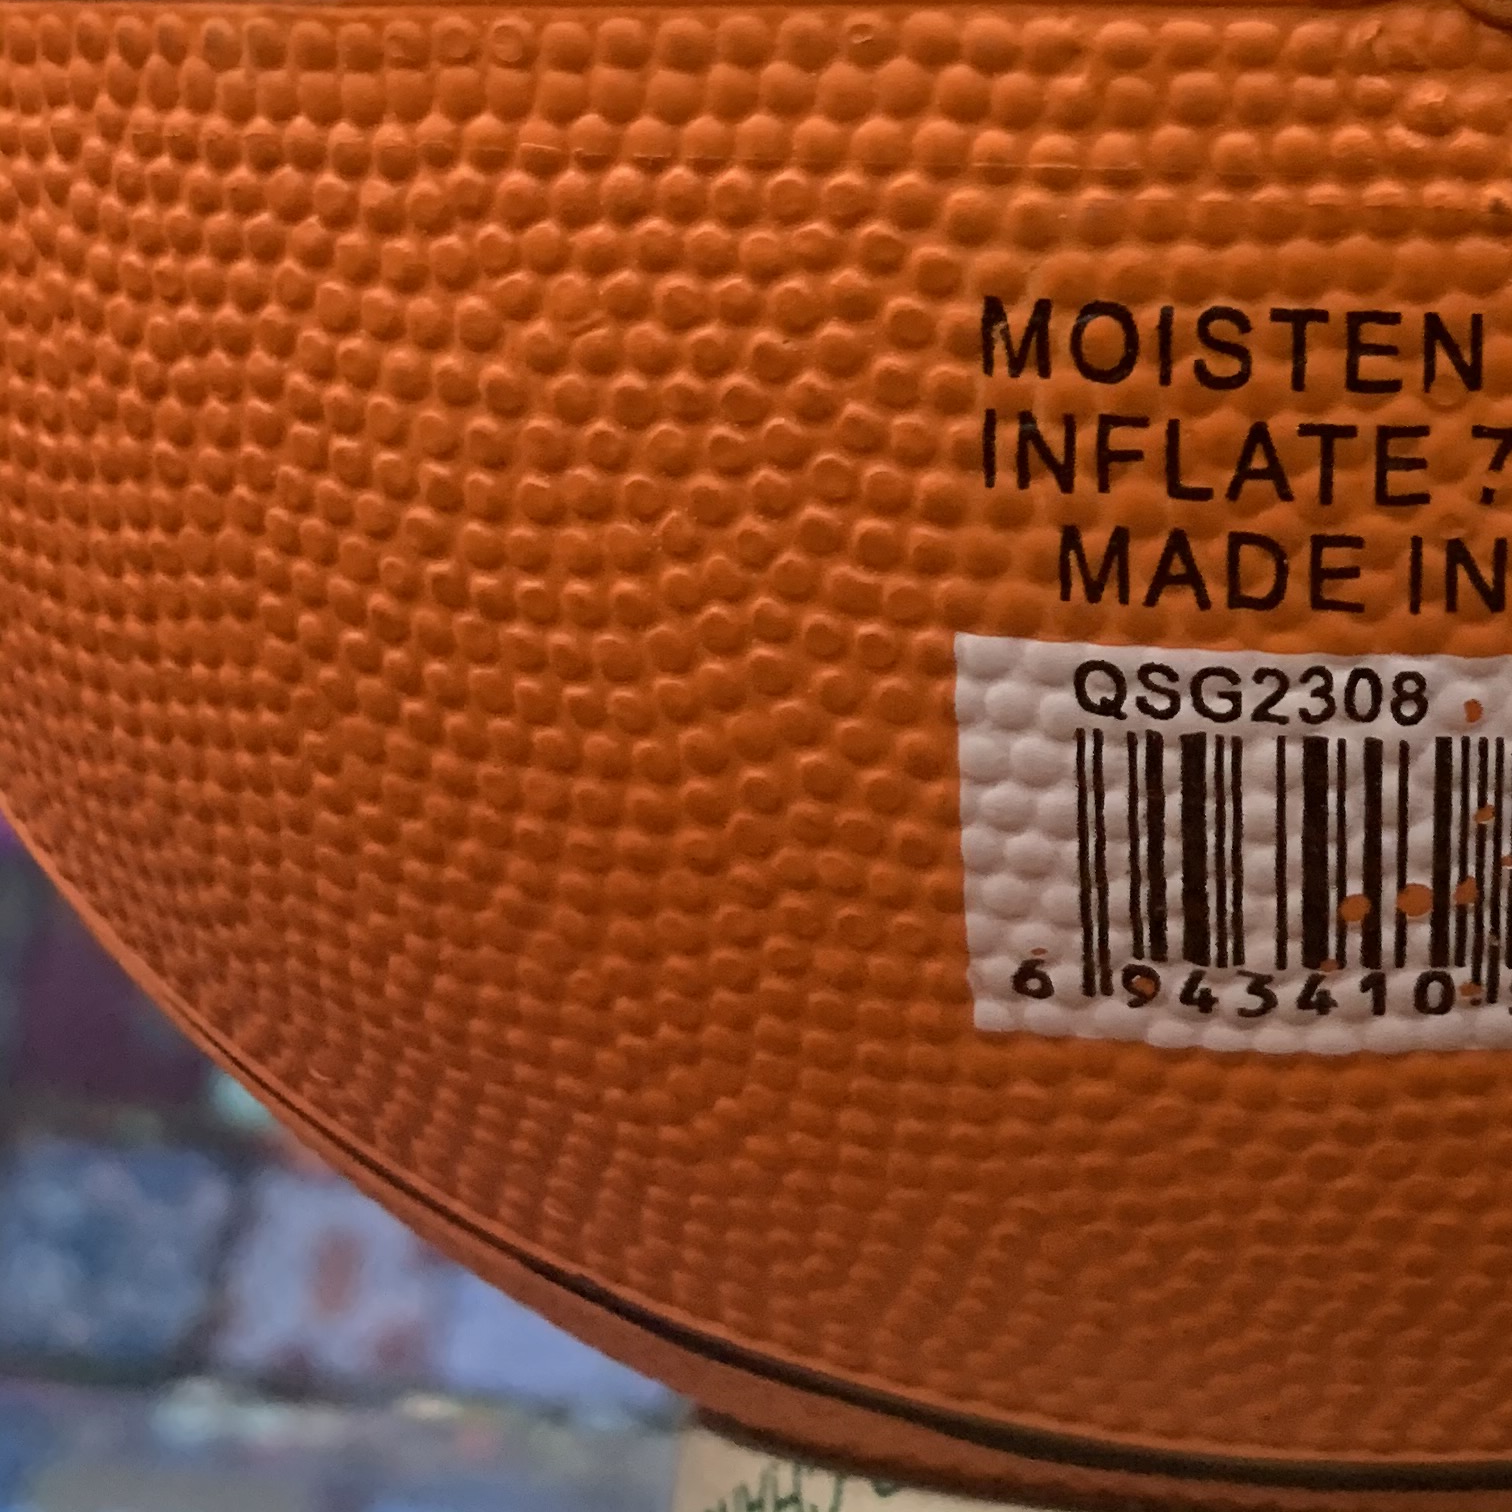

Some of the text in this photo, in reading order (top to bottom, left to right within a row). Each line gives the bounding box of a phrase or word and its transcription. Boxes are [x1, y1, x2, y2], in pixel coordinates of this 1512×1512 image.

[980, 294, 1485, 396] MOISTEN
[981, 408, 1431, 506] INFLATE
[1058, 524, 1367, 614] MADE
[1409, 535, 1509, 614] IN
[1073, 659, 1431, 727] QSG2308
